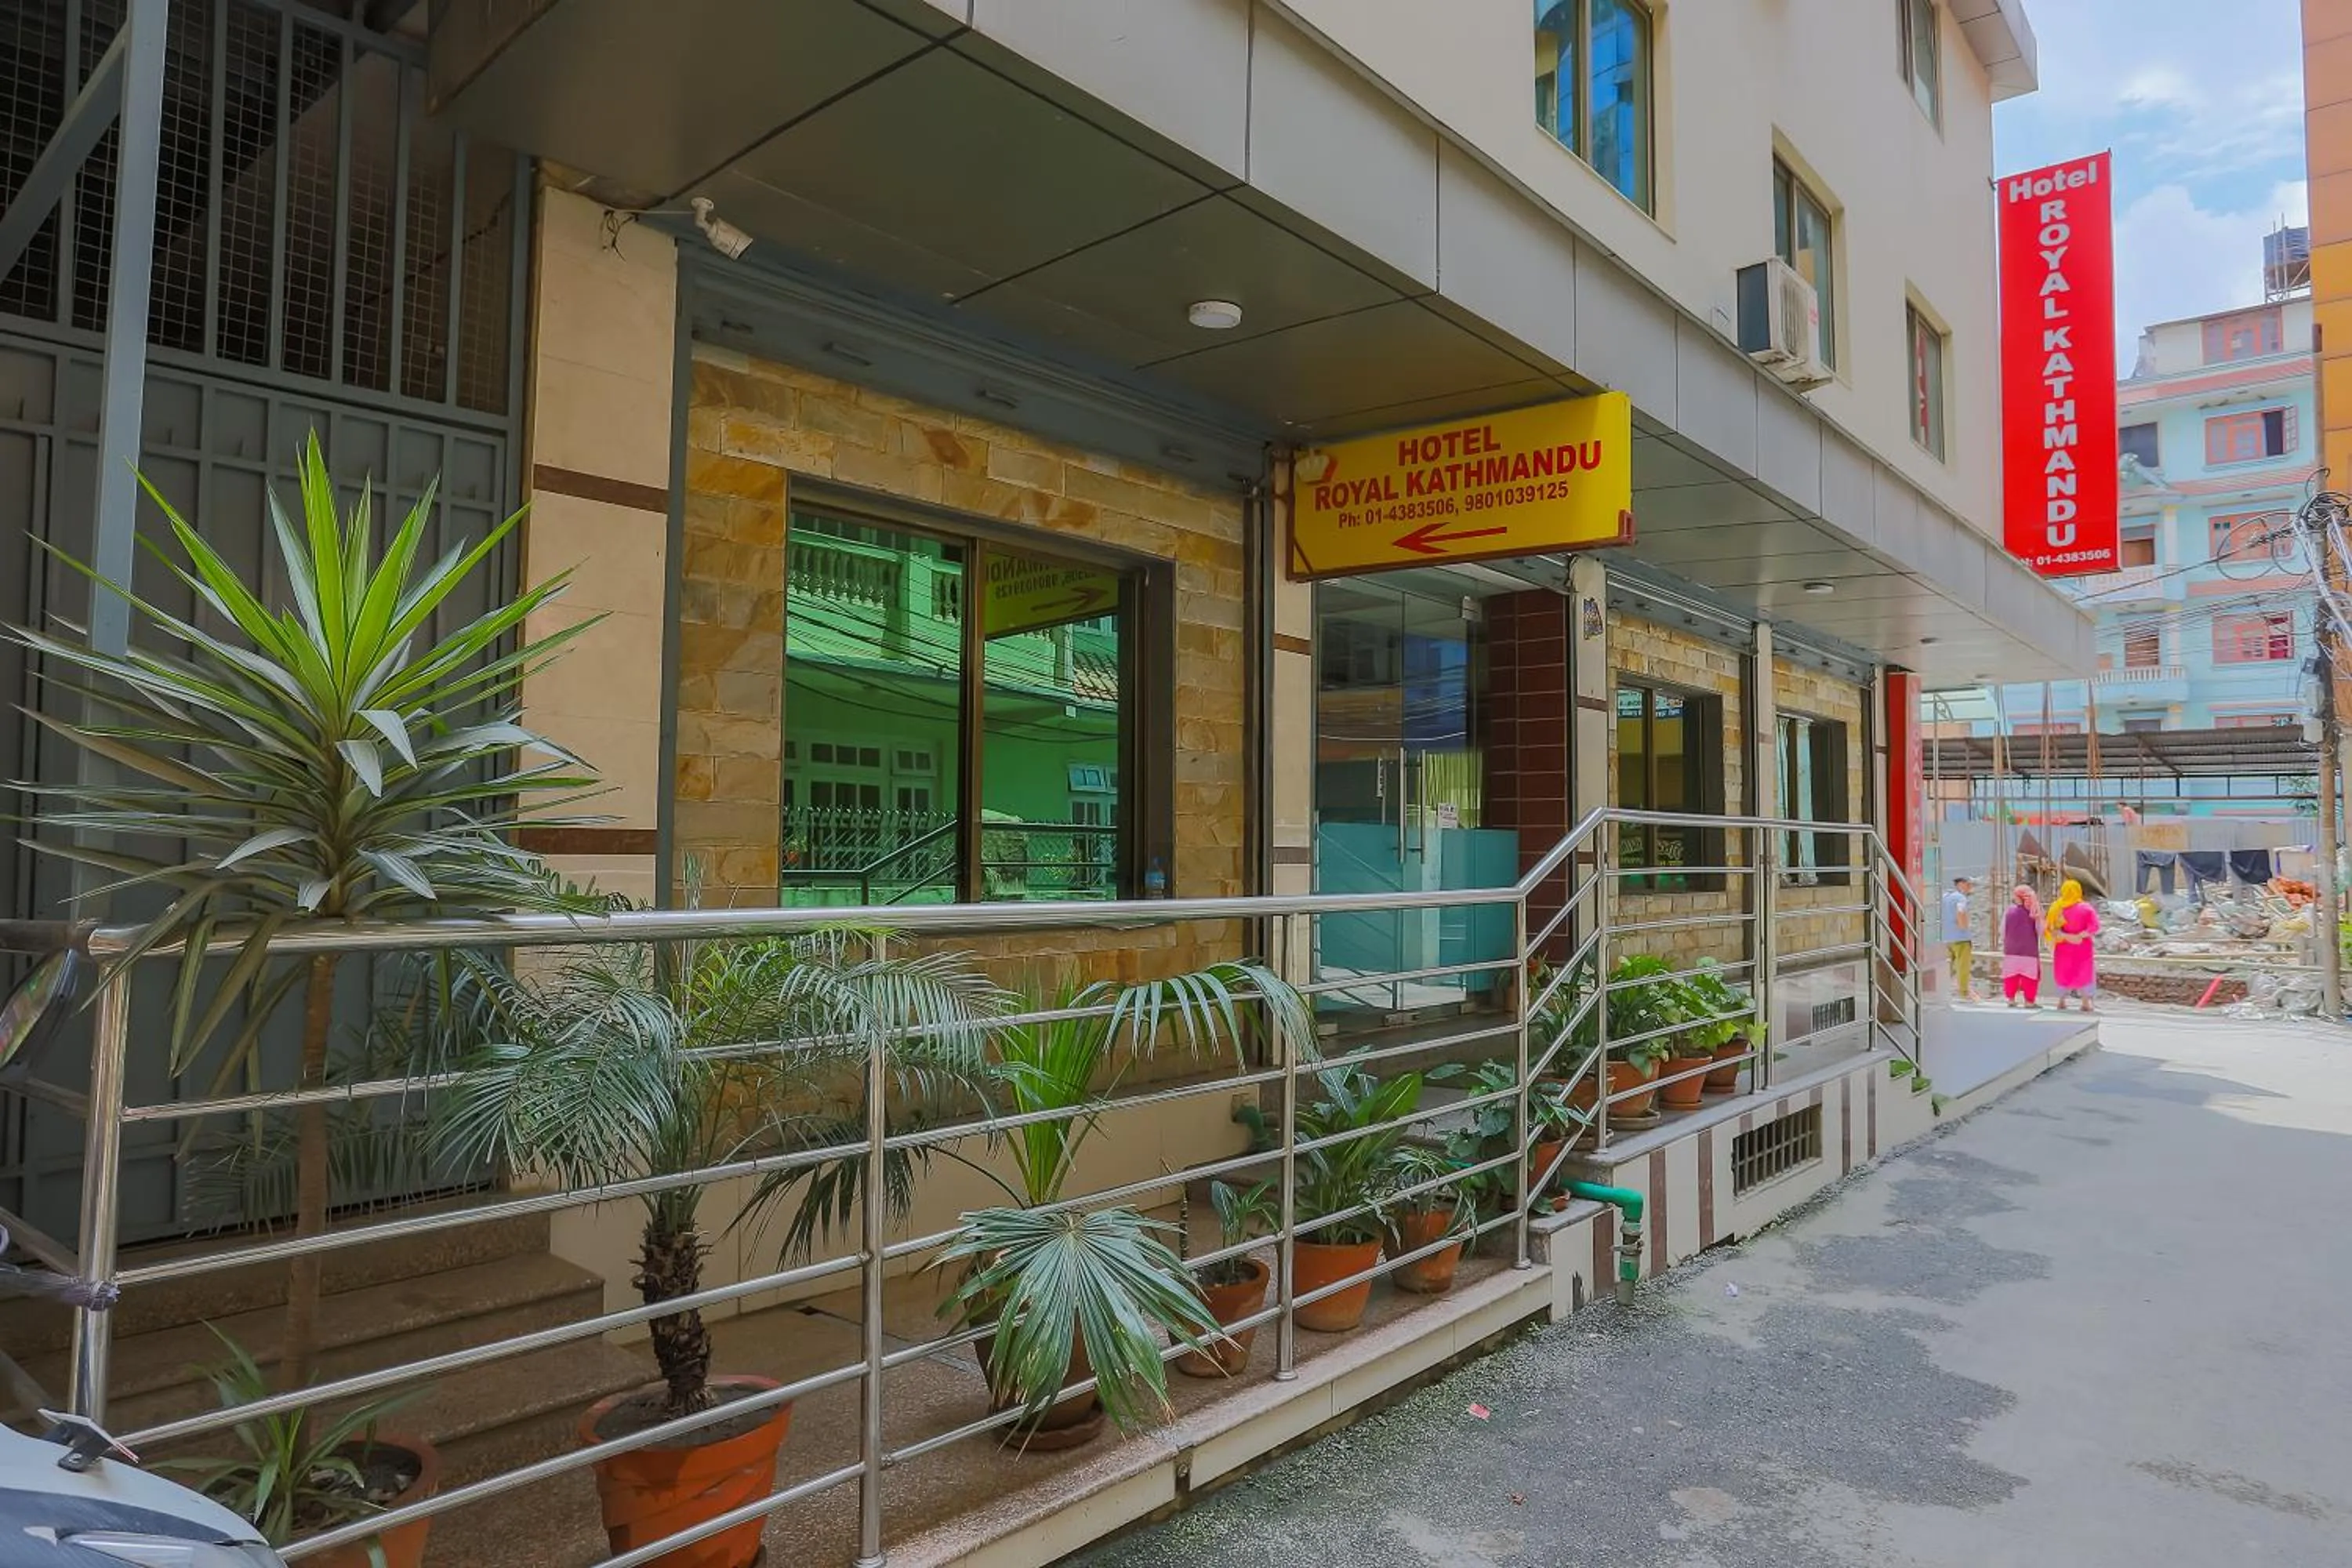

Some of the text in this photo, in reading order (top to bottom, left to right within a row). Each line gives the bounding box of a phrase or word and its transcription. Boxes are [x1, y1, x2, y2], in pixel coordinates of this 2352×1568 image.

[2009, 162, 2097, 203] Hotel
[2039, 199, 2077, 547] ROYAL KATHMANDU
[1398, 426, 1501, 466] HOTEL
[1315, 441, 1602, 511] ROYAL KATHMANDU
[1338, 481, 1568, 528] Ph: 01-4383506, 9801039125
[2037, 549, 2111, 565] 01-4383506
